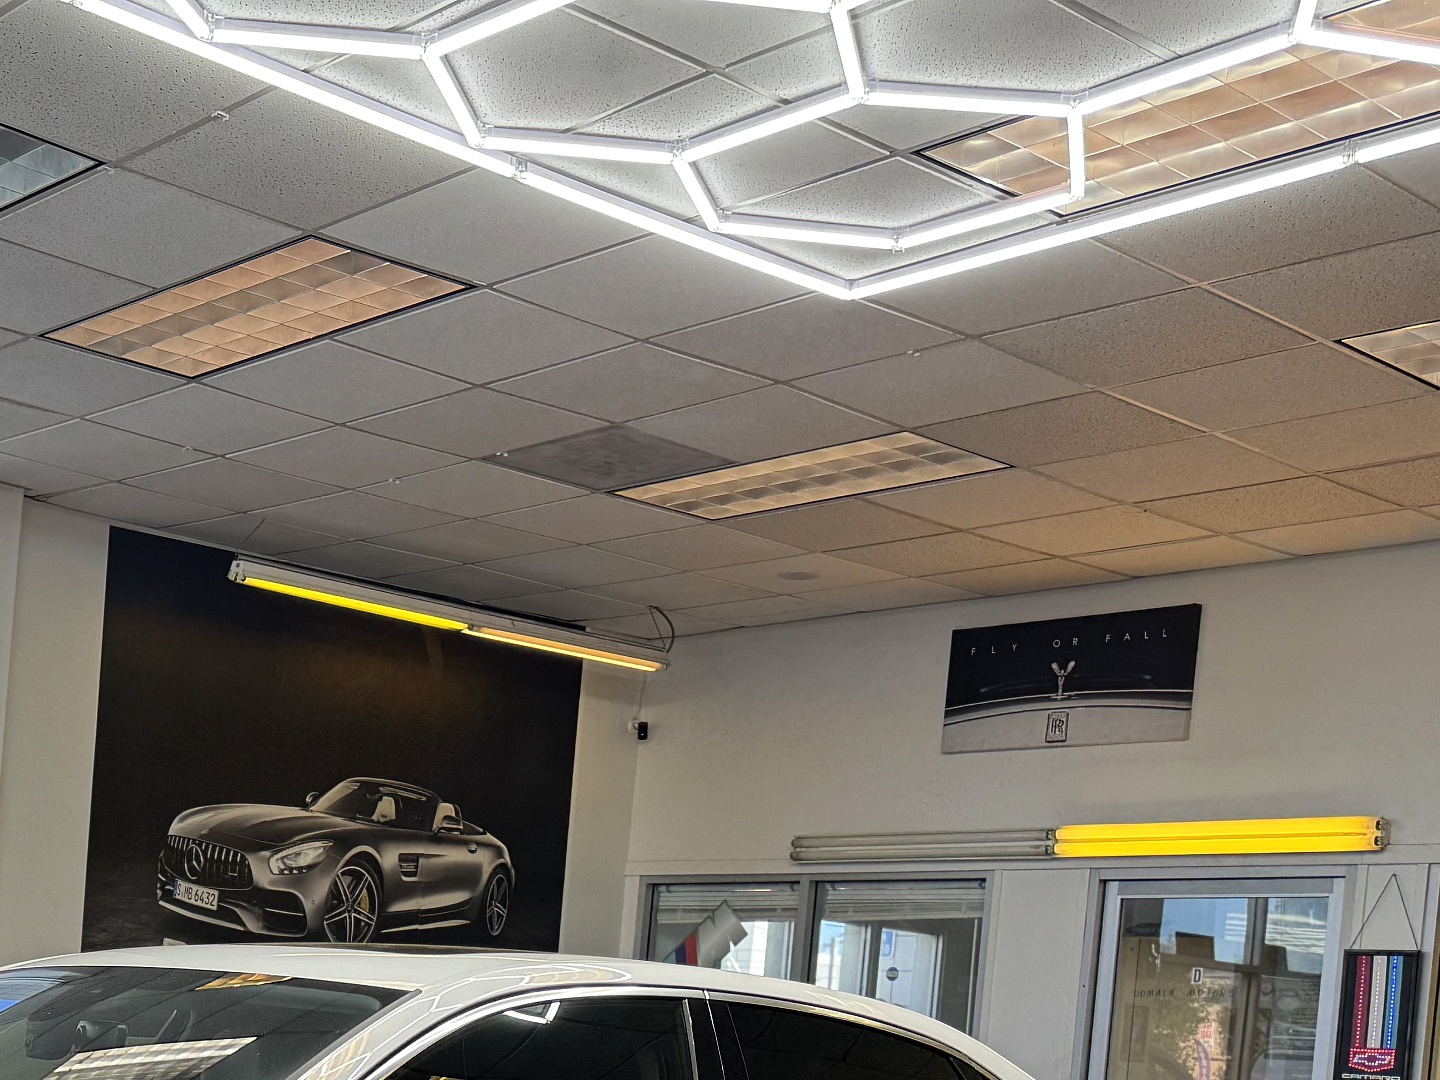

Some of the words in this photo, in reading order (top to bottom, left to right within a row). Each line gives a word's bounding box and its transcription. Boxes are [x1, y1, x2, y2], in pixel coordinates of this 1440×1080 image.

[970, 643, 1018, 656] FLY
[1052, 637, 1079, 648] OR
[1105, 629, 1168, 644] FALL
[194, 889, 216, 907] 6432
[1193, 968, 1202, 983] D
[1133, 989, 1176, 998] DOMAIN
